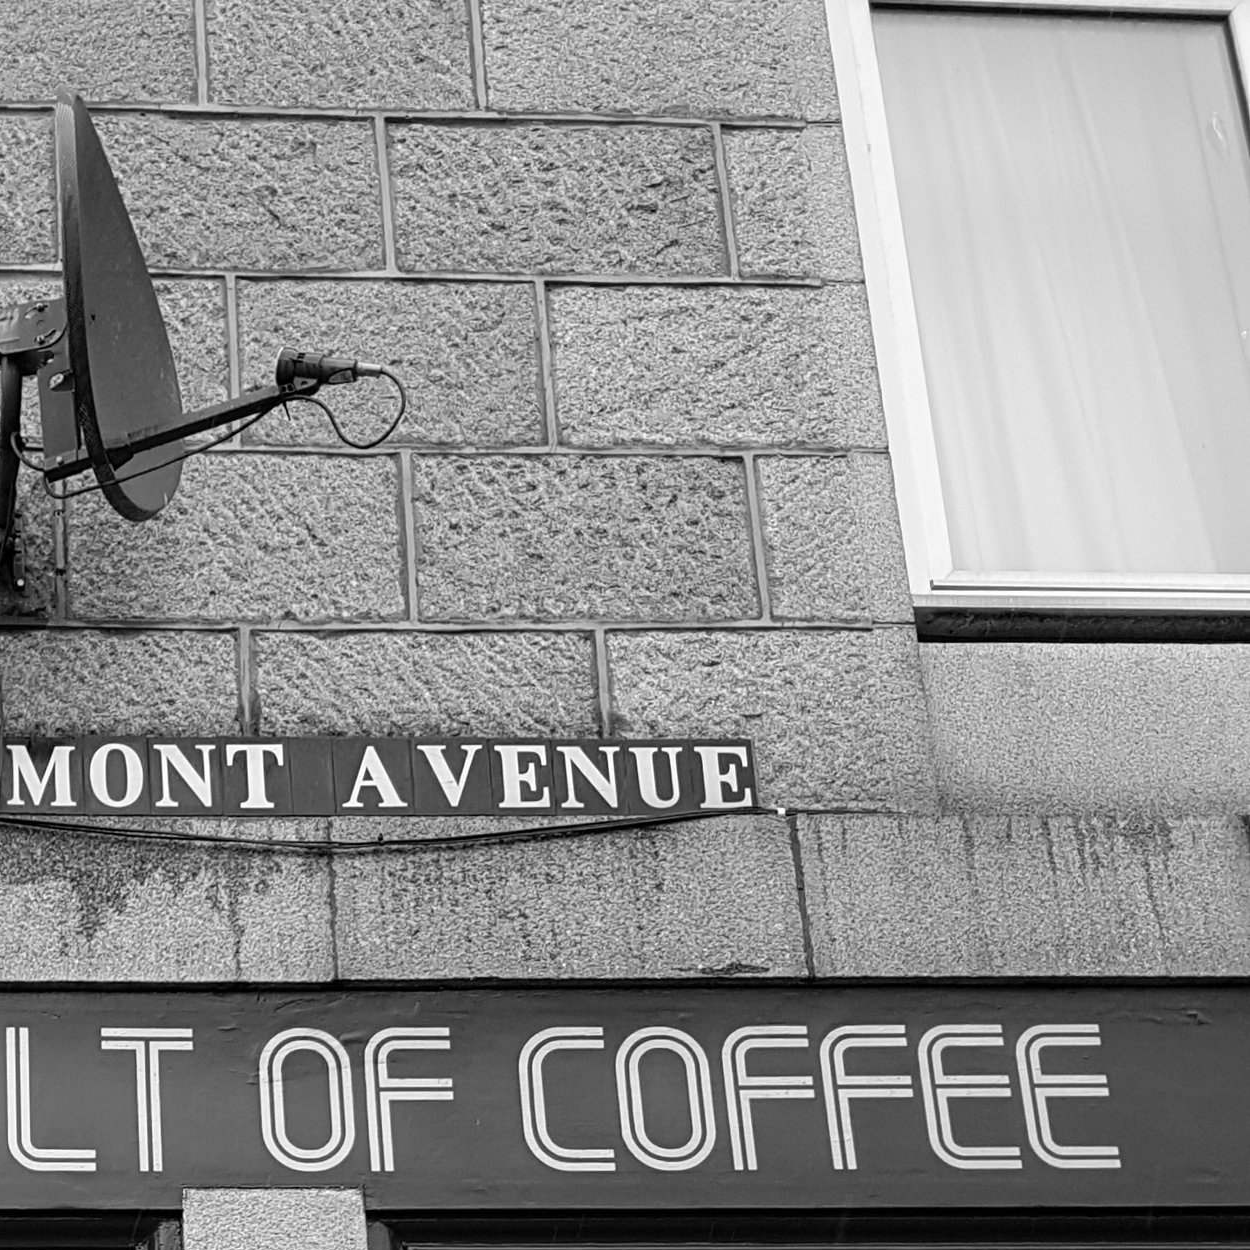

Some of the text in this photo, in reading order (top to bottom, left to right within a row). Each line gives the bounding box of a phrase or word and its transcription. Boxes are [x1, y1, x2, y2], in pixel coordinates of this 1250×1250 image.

[342, 745, 752, 808] AVENUE
[259, 1028, 453, 1171] OF
[519, 1025, 1120, 1171] COFFEE
